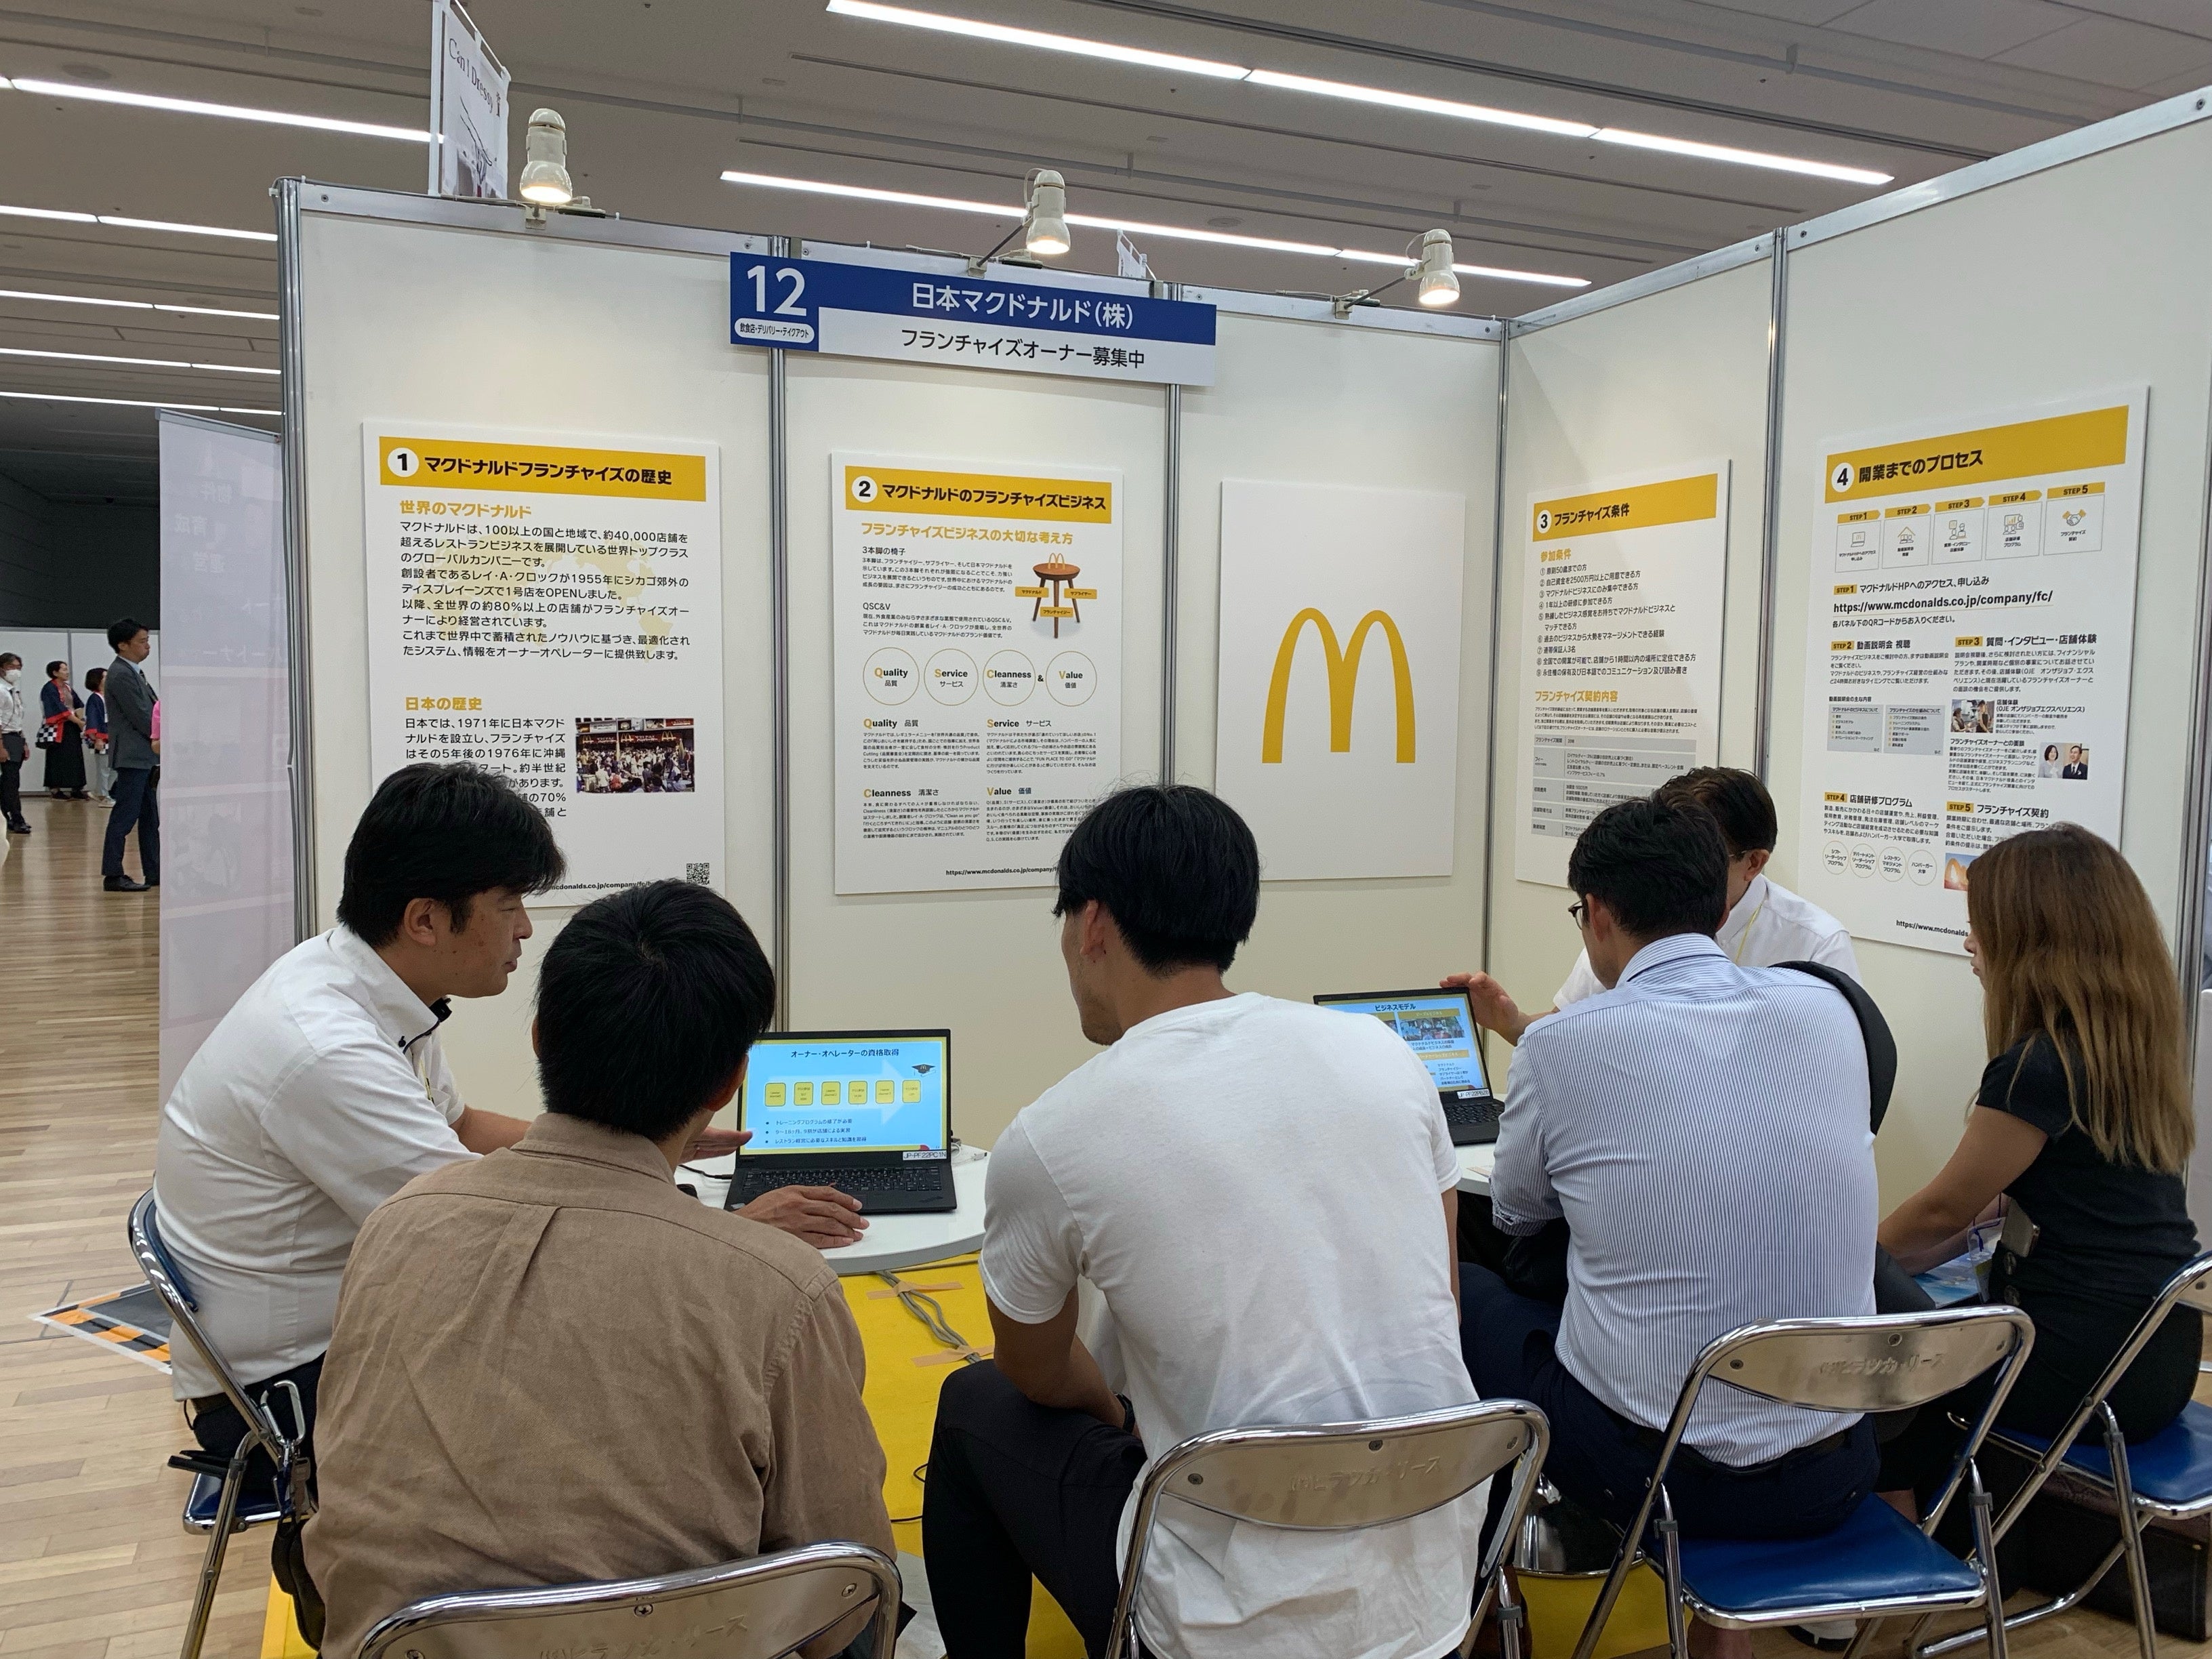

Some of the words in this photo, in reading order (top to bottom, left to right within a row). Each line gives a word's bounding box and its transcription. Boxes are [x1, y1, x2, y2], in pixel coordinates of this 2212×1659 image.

[747, 266, 806, 315] 12
[913, 283, 1133, 329] 日本マクドナルド（株）
[901, 329, 1145, 369] フランチャイズオーナー募集中
[397, 453, 408, 472] 1
[424, 456, 672, 485] マクドナルドフランチャイズの歴史
[1837, 468, 1849, 487] 4
[1859, 449, 1984, 483] 開業までのプロセス
[859, 480, 871, 497] 2
[882, 483, 1106, 510] マクドナルドのフランチャイズビジネス
[2082, 485, 2089, 493] 5
[2020, 492, 2026, 501] 4
[400, 500, 531, 519] 世界のマクドナルド
[1964, 499, 1970, 508] 3
[1540, 514, 1549, 529] 3
[1555, 503, 1630, 526] フランチャイズ条件
[1864, 512, 1867, 520] 1
[1911, 506, 1917, 514] 2
[861, 523, 1073, 545] フランチャイズビジネスの大切な考え方
[400, 536, 689, 558] 超えるレストランビジネスを展開している世界トップクラス
[862, 546, 906, 556] 3本脚の椅子
[401, 552, 546, 567] のグローバルカンパニーです。
[1540, 548, 1571, 562] 参加条件
[1860, 576, 1989, 593] マクドナルドHPへのアクセス、申し込み
[863, 602, 890, 611] QSC&V
[1833, 590, 2053, 613] https://www.mcdonalds.co.jp/company/fc/
[403, 614, 549, 628] ナーにより経営されています。
[1832, 616, 1956, 628] 各パネル下のQRコードからお入りください。
[403, 630, 691, 647] これまで世界中で蓄積されたノウハウに基づき、最適化され
[1974, 637, 1980, 646] 3
[1986, 634, 2097, 647] 質問・インタビュー・店舗体験
[1857, 640, 1893, 650] 動画説明会
[1896, 640, 1910, 649] 視聴
[403, 645, 680, 661] たシステム、情報をオーナーオペレーターに提供致します。
[874, 668, 908, 678] Quality
[935, 669, 968, 678] Service
[987, 669, 1031, 678] Cleanness
[1038, 674, 1044, 682] &
[1059, 670, 1084, 680] Value
[939, 680, 964, 688] サービス
[1535, 690, 1618, 703] フランチャイズ契約内容
[405, 697, 483, 712] 日本の歴史
[405, 717, 565, 729] 日本では、1971年に日本マクド
[863, 718, 897, 729] Quality
[987, 719, 1019, 729] Service
[1025, 720, 1052, 728] サービス
[405, 733, 565, 744] ナルドを設立し、フランチャイズ
[407, 747, 566, 759] はその5年後の1976年に沖縄
[863, 788, 912, 798] Cleanness
[918, 789, 940, 797] 清潔さ
[987, 787, 1012, 796] Value
[1018, 787, 1031, 795] 価値
[1849, 794, 1912, 808] 店舗研修プログラム
[1965, 803, 1971, 811] 5
[1977, 804, 2049, 819] フランチャイズ契約
[1375, 1003, 1416, 1012] ビジネスモデル
